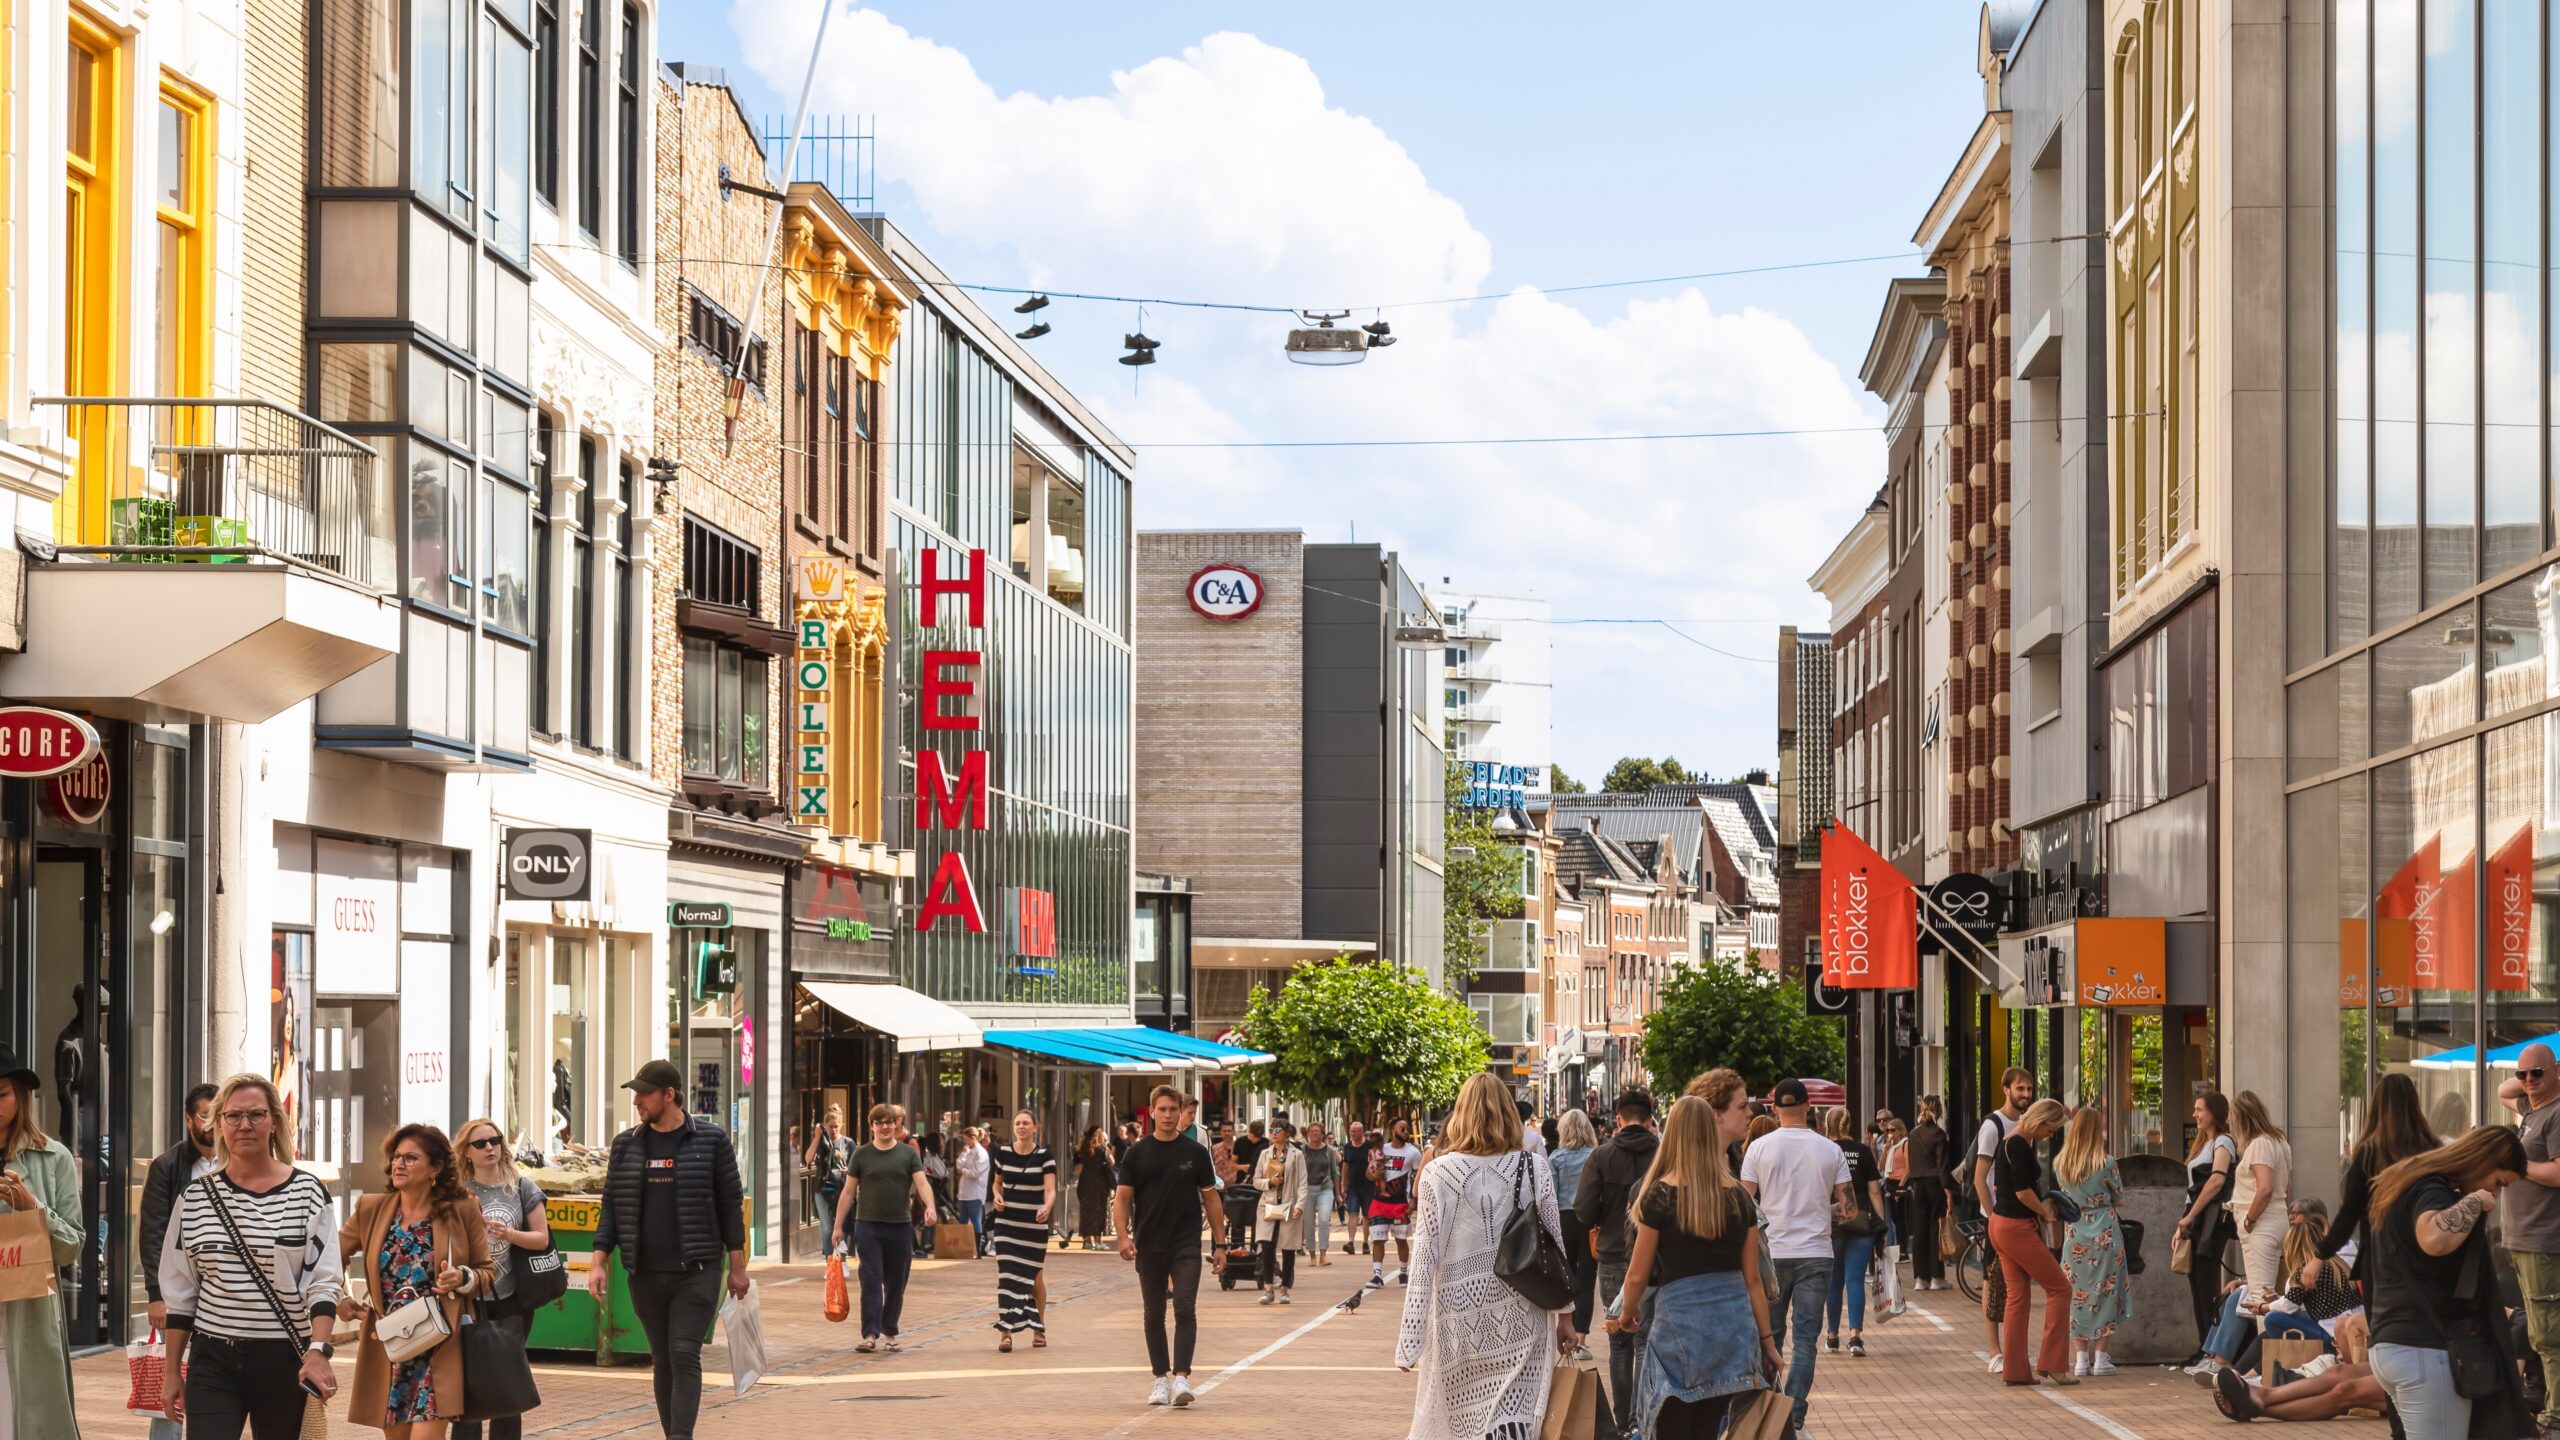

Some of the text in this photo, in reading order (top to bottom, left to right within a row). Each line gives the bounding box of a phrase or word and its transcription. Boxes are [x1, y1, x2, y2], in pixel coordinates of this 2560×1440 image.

[1201, 579, 1250, 604] C&A
[801, 620, 828, 815] ROLEX
[0, 727, 71, 757] CORE
[915, 547, 988, 933] HEMA
[1459, 785, 1525, 811] ORDEN
[513, 856, 581, 873] ONLY
[335, 898, 375, 932] GUESS
[678, 906, 722, 921] Normal
[1935, 918, 1996, 929] hunemöller
[2083, 983, 2161, 1000] bkker.
[406, 1052, 443, 1084] GUESS
[0, 1246, 21, 1268] &M
